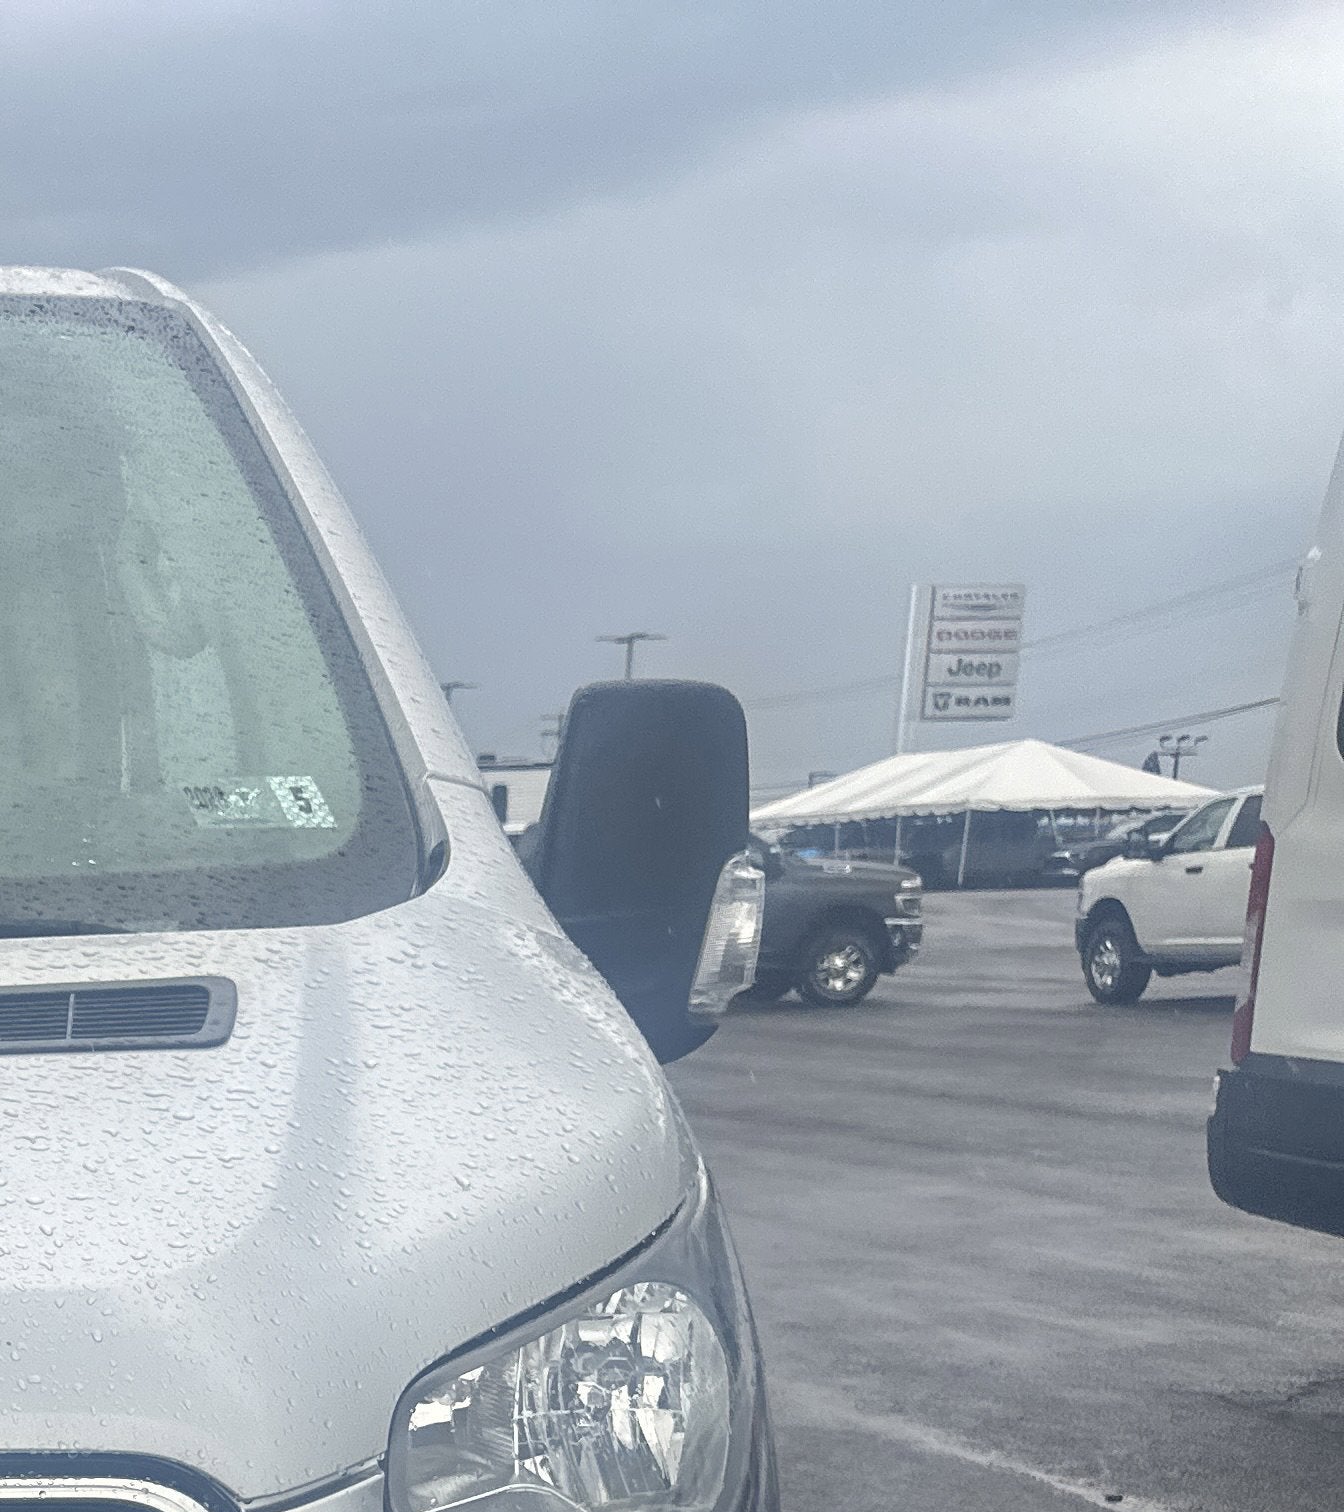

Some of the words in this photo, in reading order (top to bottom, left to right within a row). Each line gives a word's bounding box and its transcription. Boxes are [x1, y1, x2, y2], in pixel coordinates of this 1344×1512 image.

[947, 658, 1002, 679] Jeep
[954, 696, 1011, 706] RAM
[289, 786, 313, 814] 5
